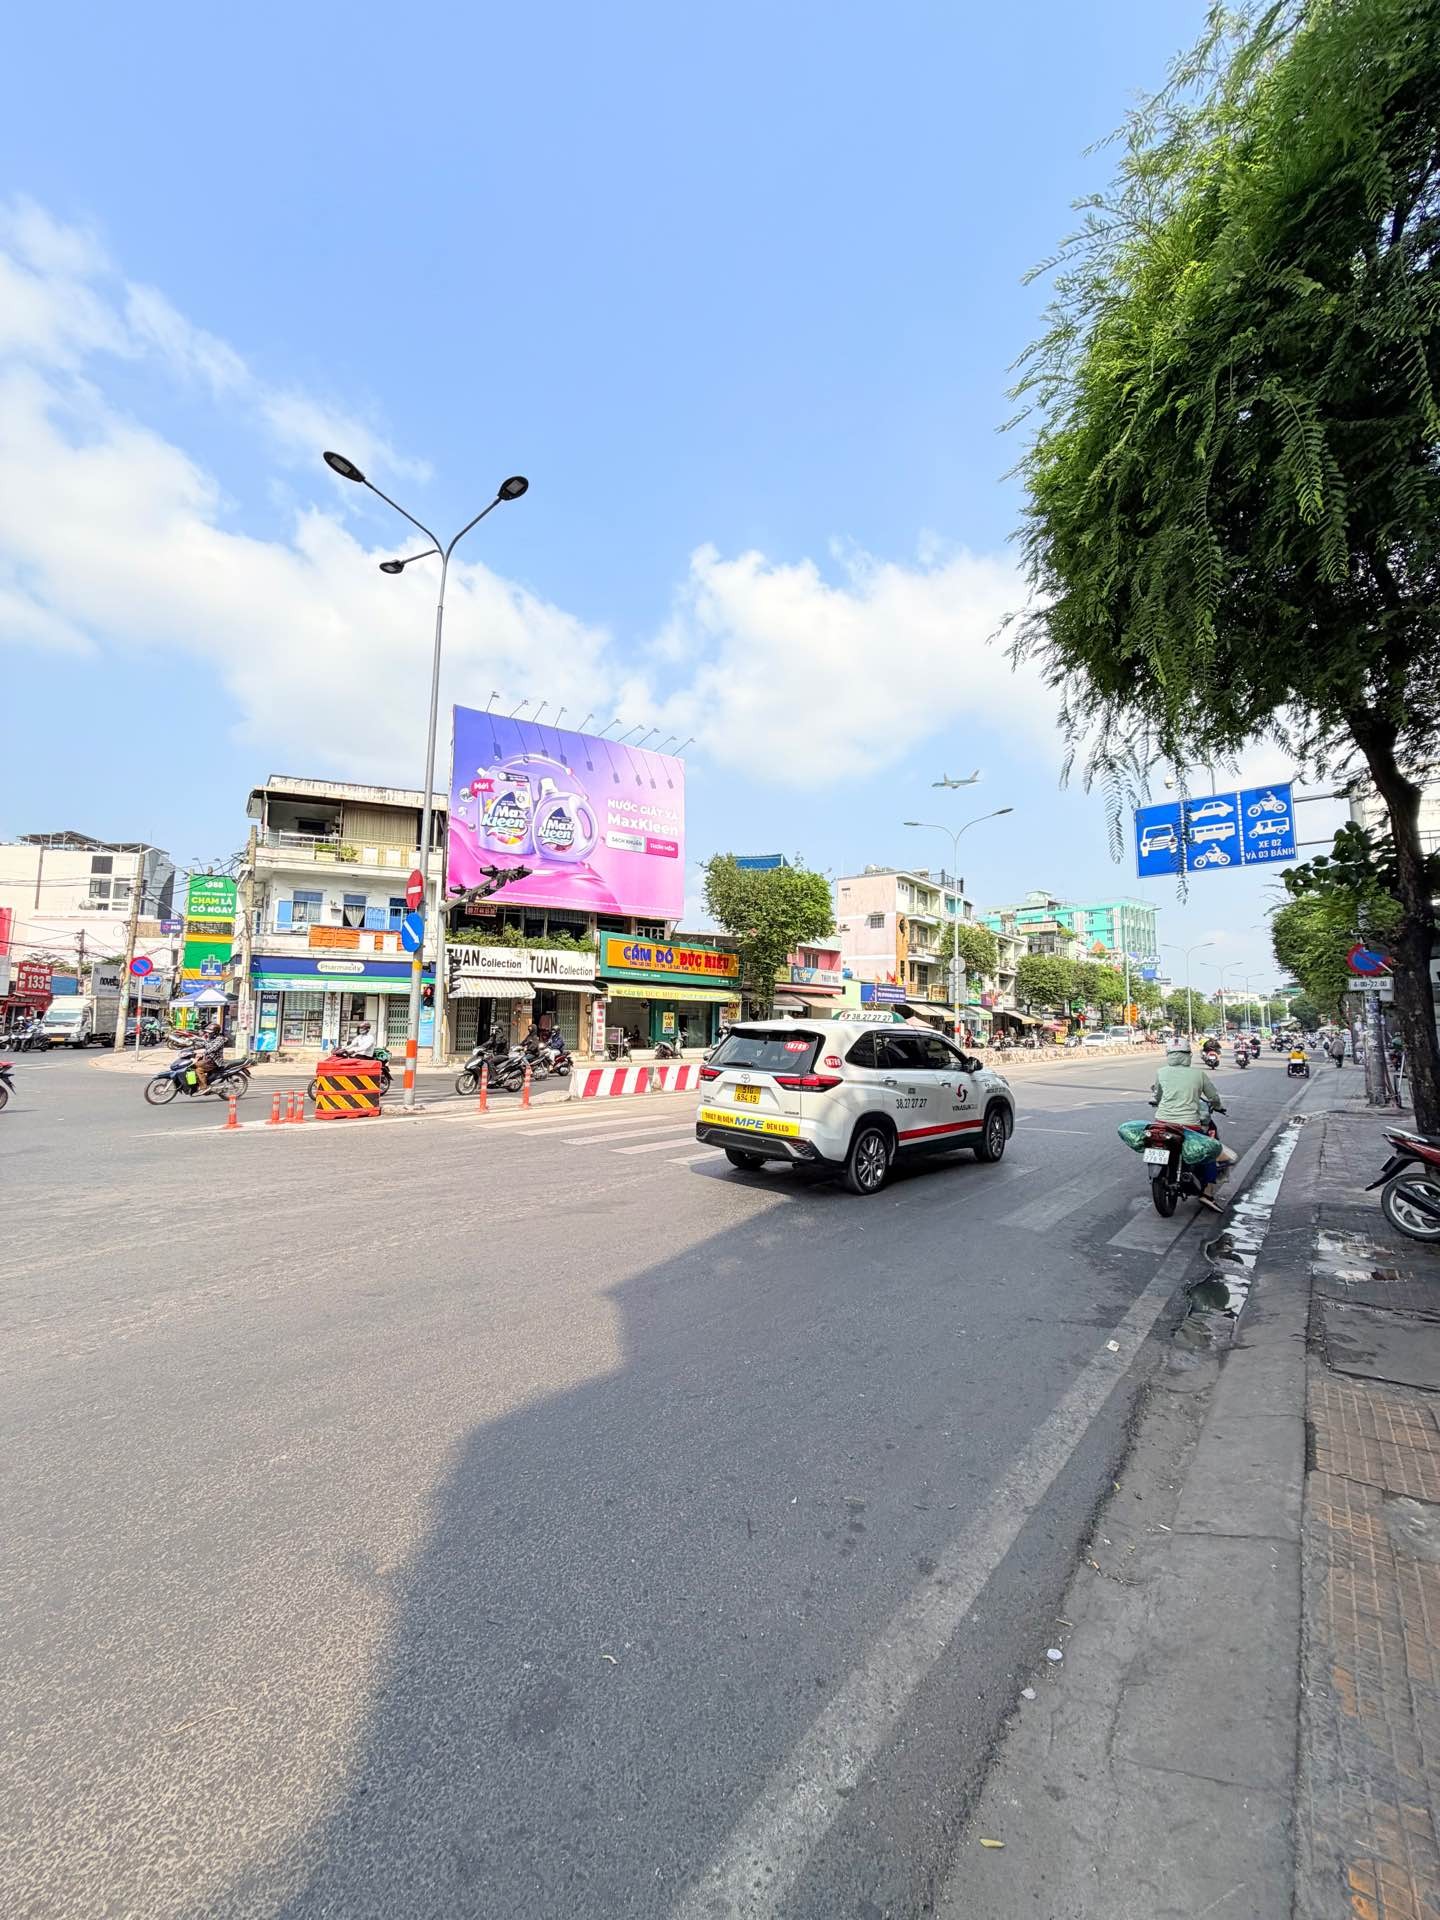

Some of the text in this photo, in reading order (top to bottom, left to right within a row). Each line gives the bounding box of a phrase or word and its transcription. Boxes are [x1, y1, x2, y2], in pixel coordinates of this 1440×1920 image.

[495, 805, 528, 818] Max
[608, 799, 638, 813] NƯỚC
[547, 819, 575, 830] Max
[607, 812, 678, 837] MaxKleen
[1258, 839, 1281, 849] XE 02
[1246, 847, 1295, 861] VÀ 03 BÁNH
[207, 906, 234, 914] NGAY
[480, 957, 522, 969] Collection
[529, 956, 557, 975] TUAN
[559, 964, 593, 976] Collection
[28, 975, 45, 988] 133
[735, 1116, 765, 1129] MPE
[778, 1123, 789, 1132] LED
